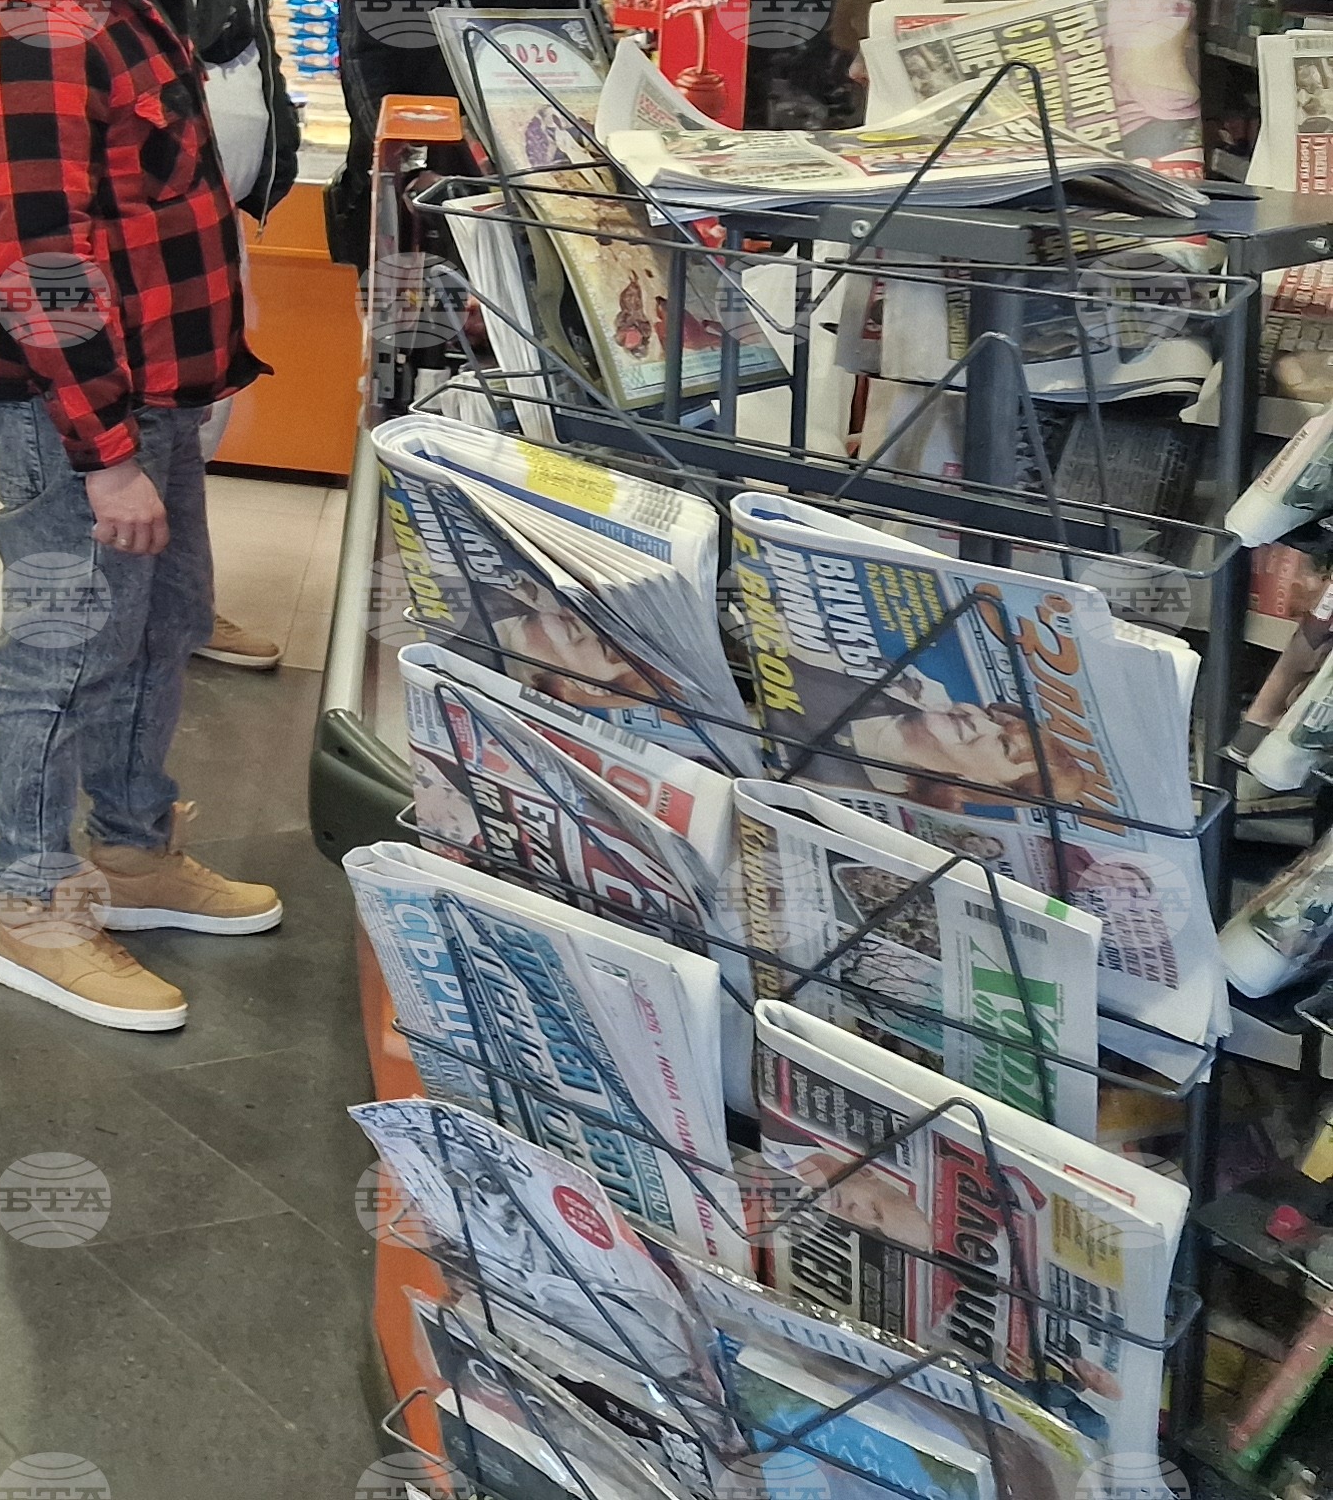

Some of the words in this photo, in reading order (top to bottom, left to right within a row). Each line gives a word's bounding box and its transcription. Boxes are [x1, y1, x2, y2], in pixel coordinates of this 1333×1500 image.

[1003, 20, 1050, 38] С
[1051, 3, 1117, 116] ПЪРВИЯТ
[385, 497, 454, 621] ВИСОК
[397, 472, 463, 578] ДИМИ
[736, 564, 805, 716] ВИСОК
[760, 540, 829, 654] ДИМИ
[809, 555, 887, 685] ВНУКЪТ
[917, 571, 945, 625] Богдан
[469, 775, 507, 810] на
[736, 817, 775, 949] Ключови
[1101, 937, 1126, 973] БЛОК
[1144, 962, 1162, 983] НА
[1149, 908, 1180, 991] РАЗРУШИЛИ
[467, 948, 582, 1156] ПЕНСИОН
[632, 1121, 668, 1212] РЖДЕСТВО
[657, 1056, 683, 1101] НОВА
[672, 1107, 704, 1175] ГОДИА
